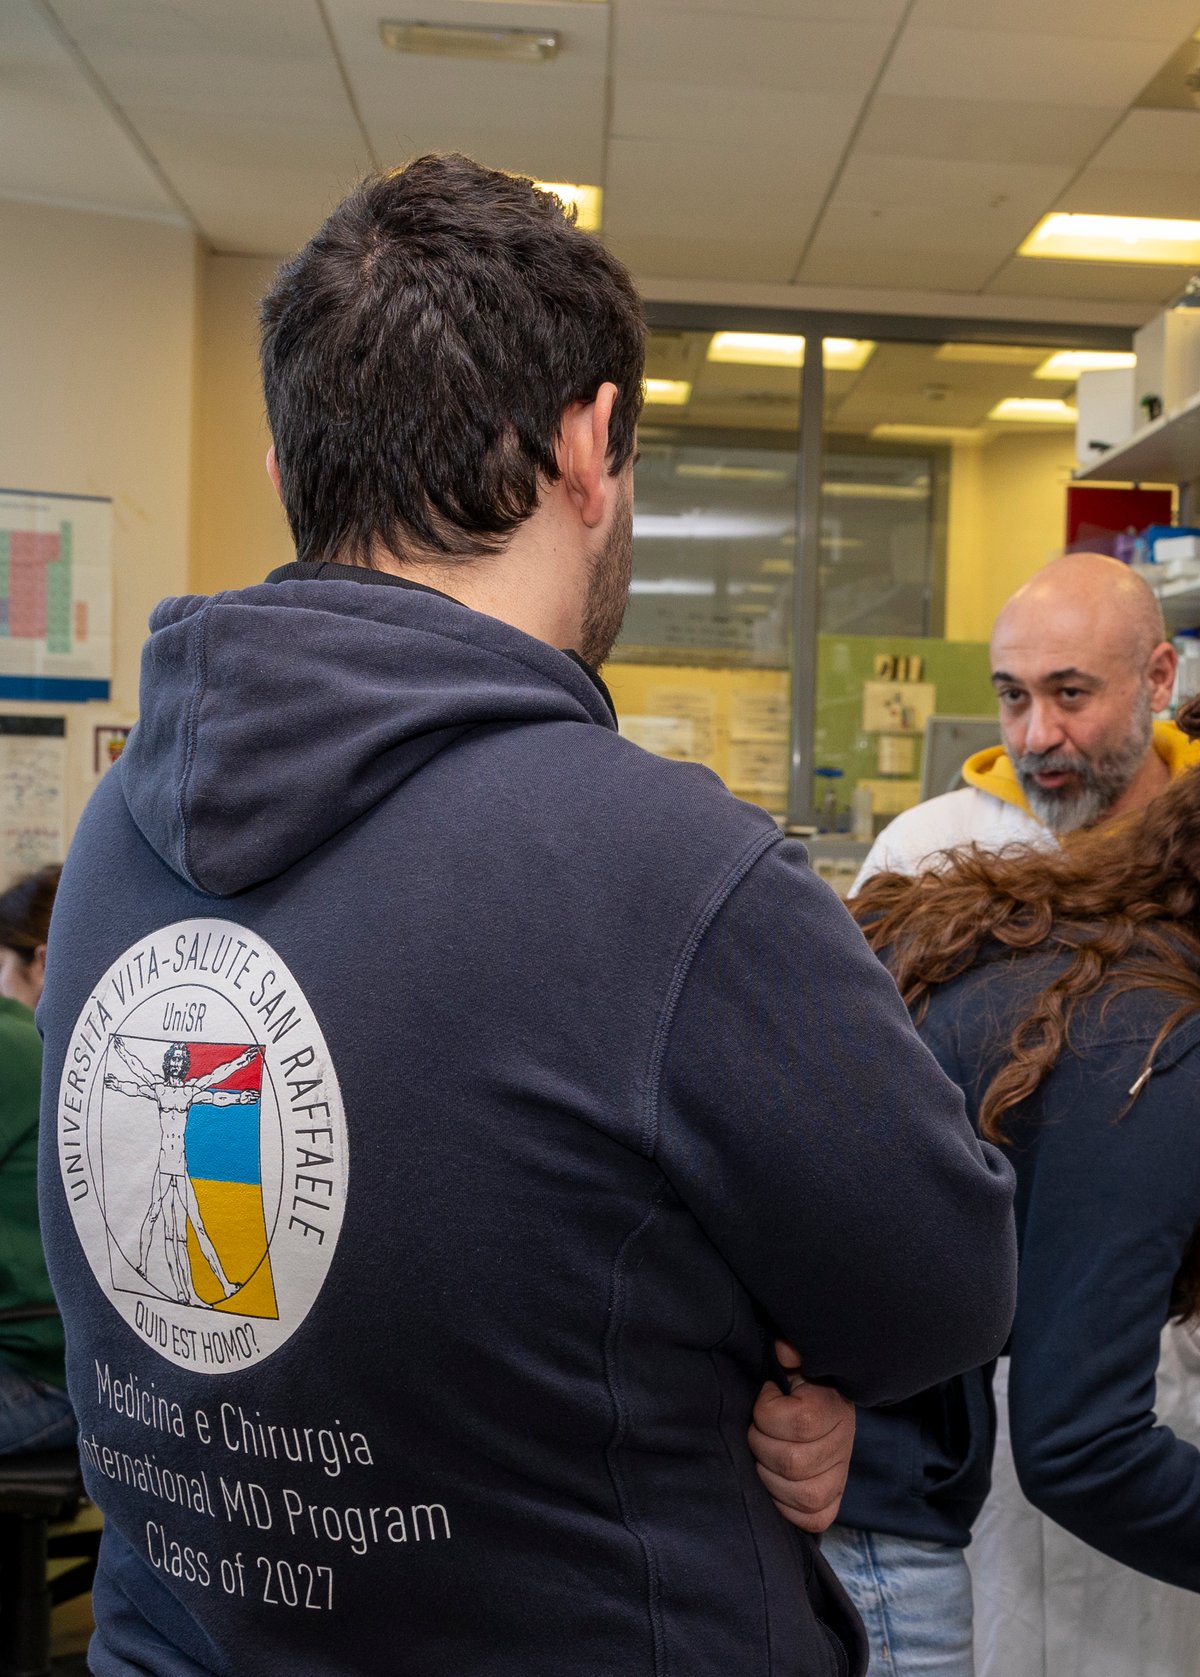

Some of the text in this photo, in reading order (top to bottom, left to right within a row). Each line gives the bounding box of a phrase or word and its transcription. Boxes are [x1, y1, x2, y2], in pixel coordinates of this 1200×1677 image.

[162, 1002, 205, 1033] UniSR
[62, 934, 333, 1245] UNIVERSITÀ VITA-SALUTE SAN RAFFAELE
[135, 1300, 260, 1364] QUID EST HOMO?
[96, 1359, 374, 1478] Medicina e Chirurgia
[81, 1434, 452, 1555] nternational MD Program
[146, 1521, 334, 1610] Class of 2027
